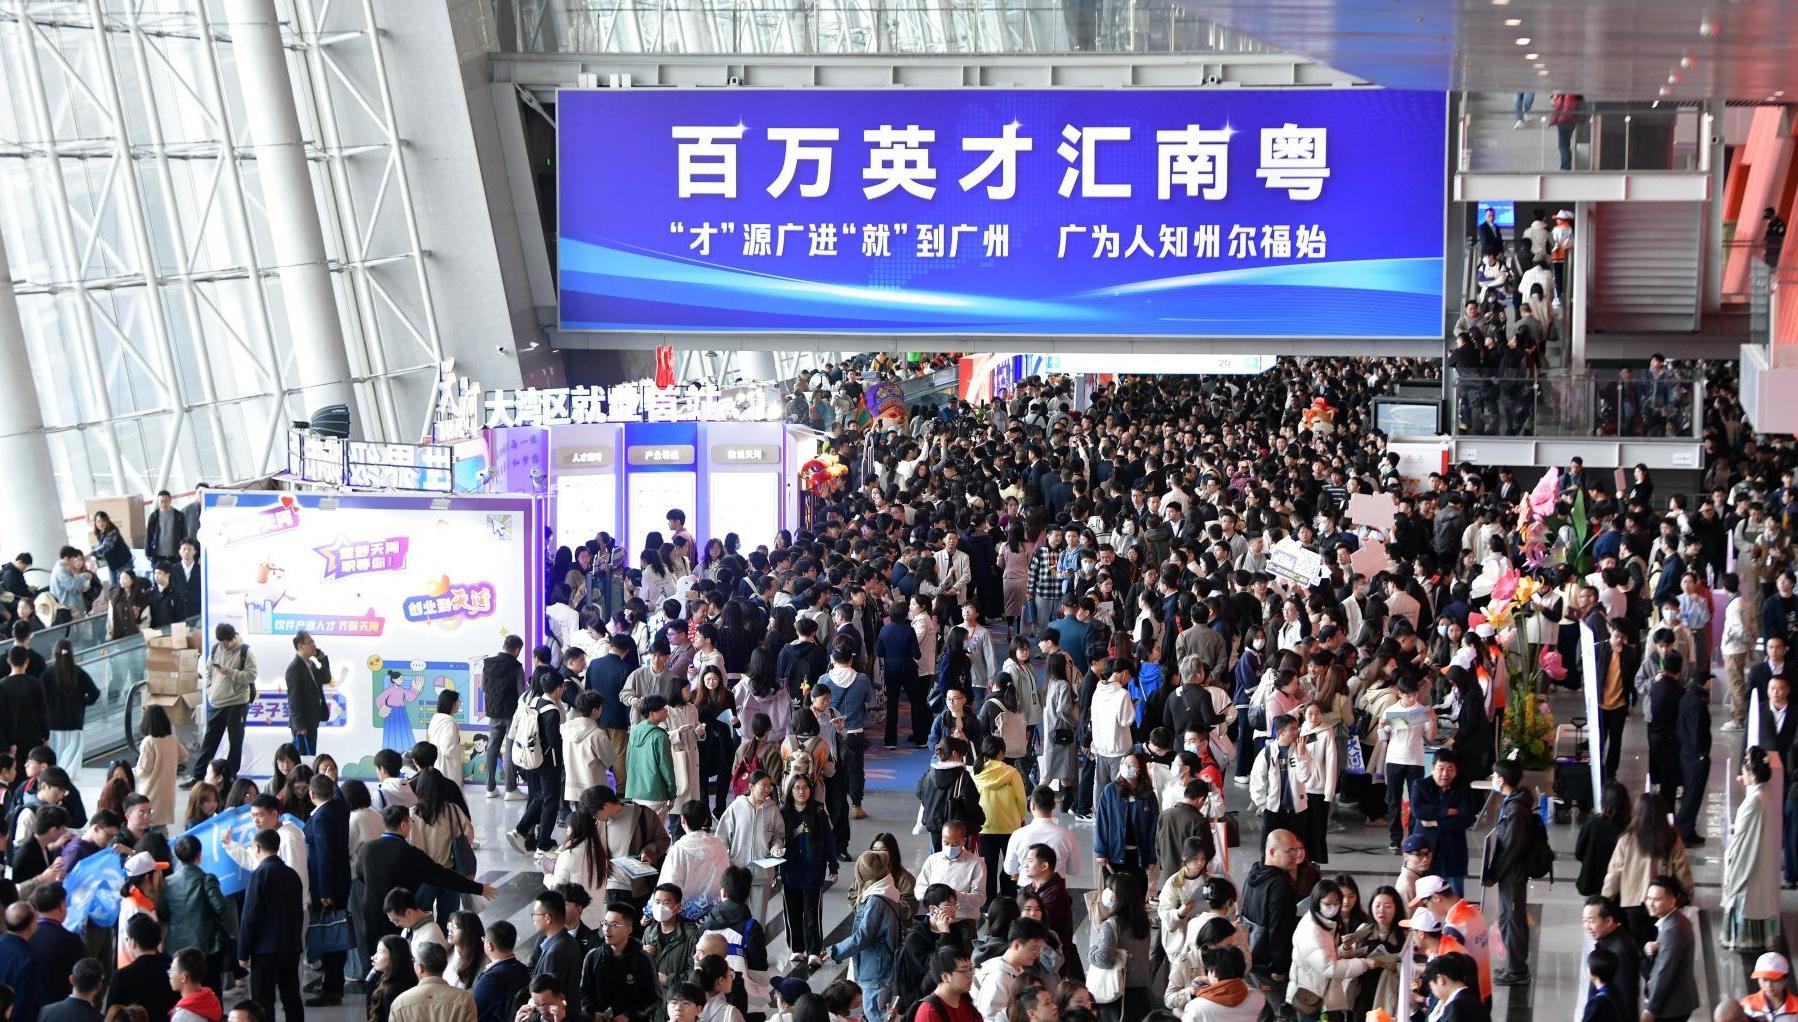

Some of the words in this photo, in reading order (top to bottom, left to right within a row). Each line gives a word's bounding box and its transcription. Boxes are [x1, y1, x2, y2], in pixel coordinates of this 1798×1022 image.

[671, 122, 1331, 201] 百万英才汇南粤
[1057, 223, 1327, 259] 广为人知州尔福始
